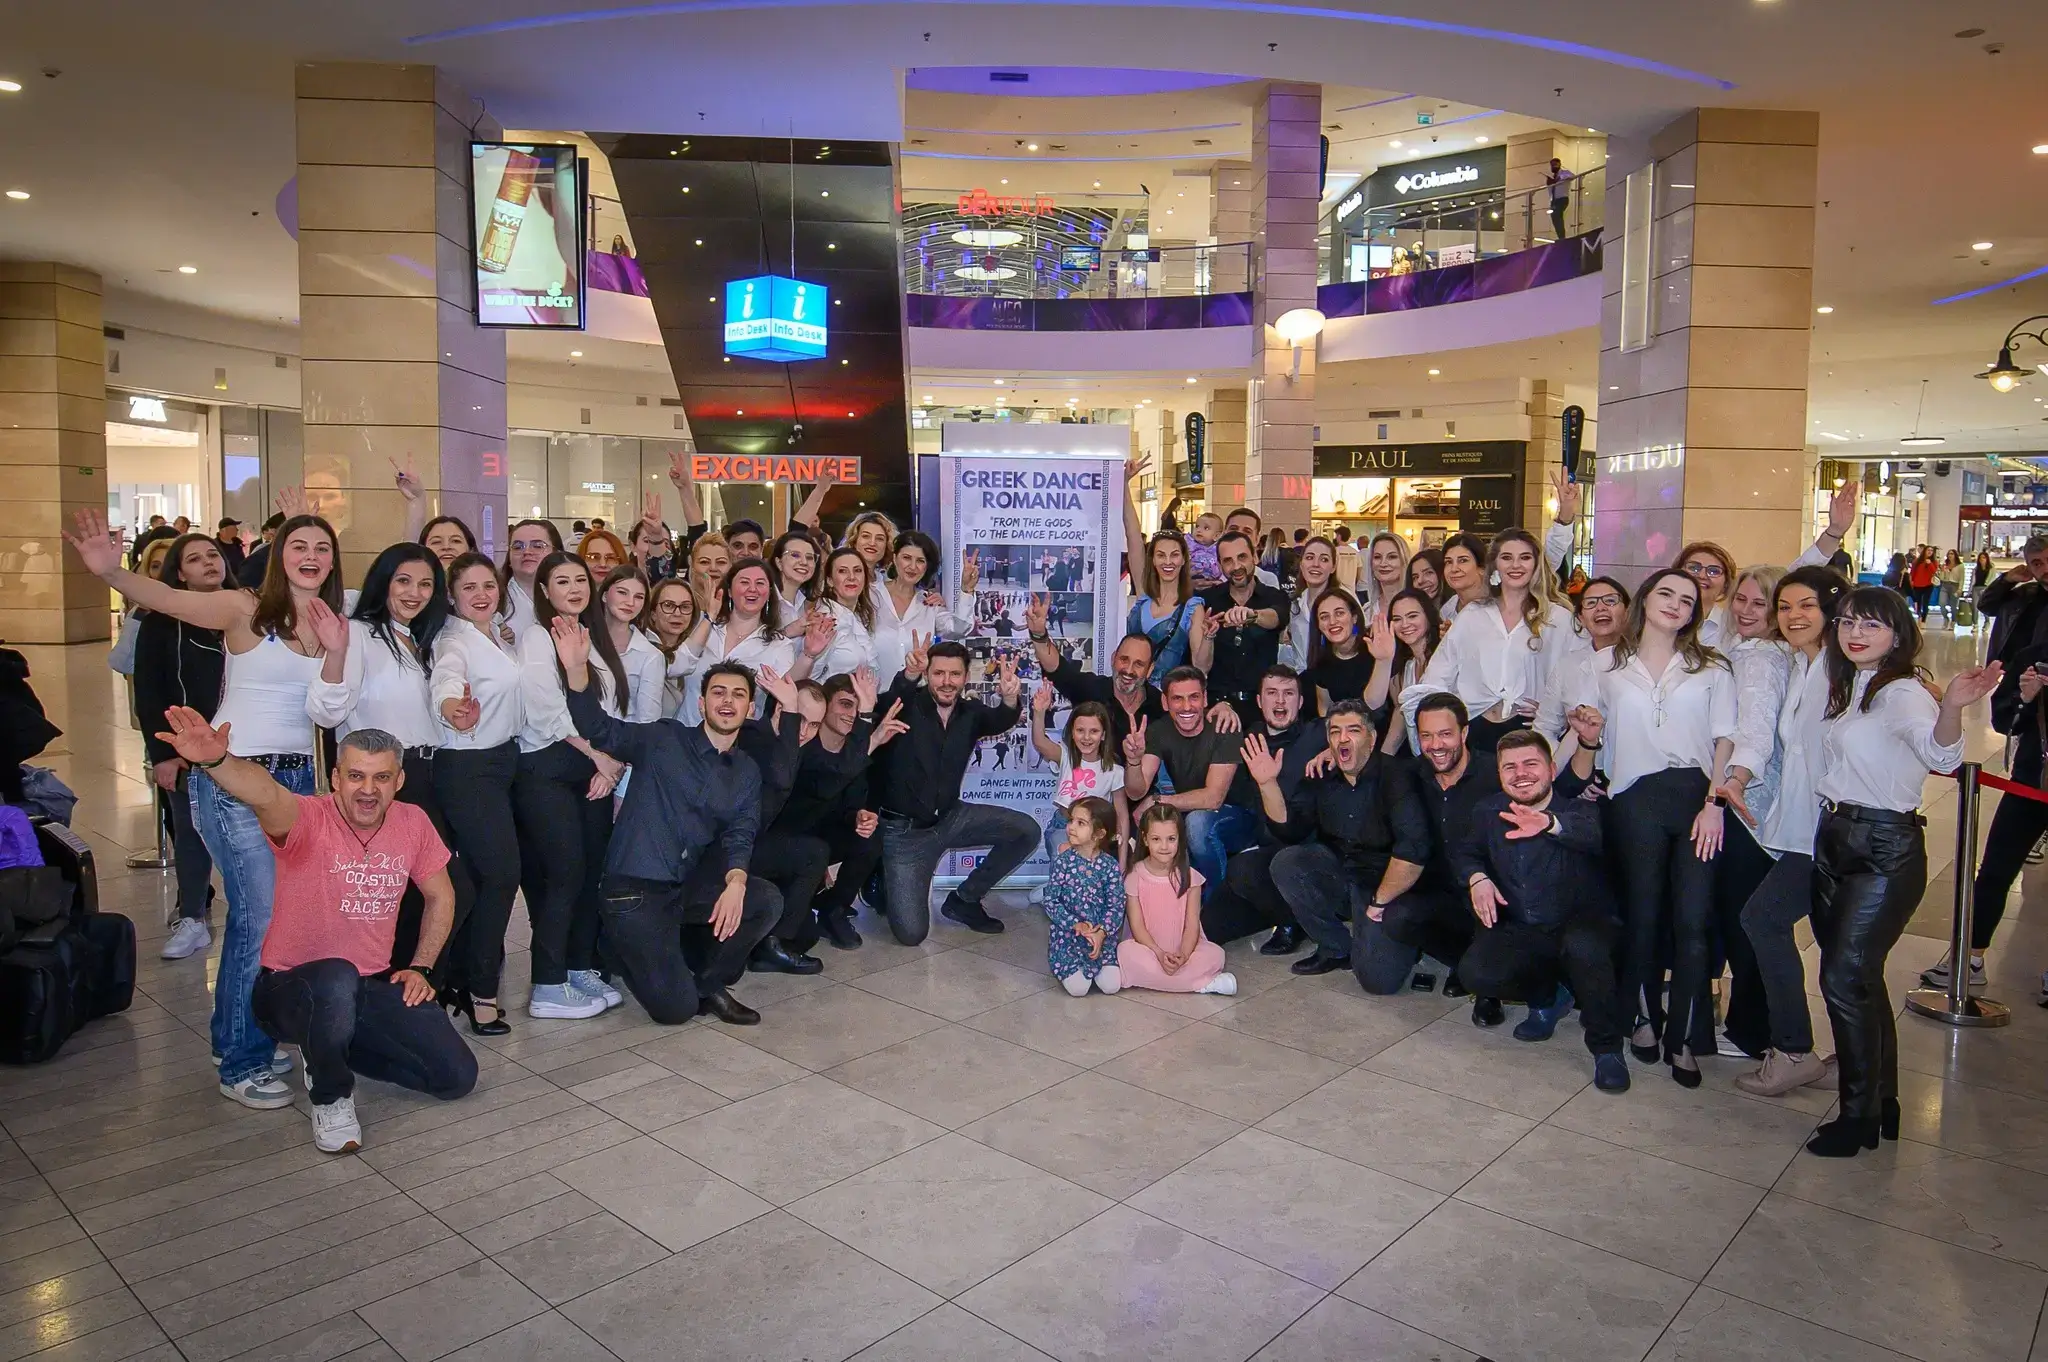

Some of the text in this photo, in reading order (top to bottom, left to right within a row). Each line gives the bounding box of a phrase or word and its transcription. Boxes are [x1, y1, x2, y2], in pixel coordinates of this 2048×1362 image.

[1411, 165, 1479, 190] Columbia
[958, 190, 1055, 216] DERTOUR
[483, 294, 515, 306] WHAT
[517, 295, 536, 307] THE
[728, 324, 768, 337] Info Desk
[774, 323, 822, 340] Info Desk
[1350, 450, 1414, 468] PAUL
[691, 455, 857, 482] EXCHANGE
[962, 470, 1102, 490] GREEK DANCE
[982, 491, 1083, 510] ROMANIA
[1469, 499, 1502, 510] PAUL
[1023, 517, 1042, 527] THE
[1044, 518, 1072, 528] GODS
[973, 529, 986, 539] TO
[990, 529, 1008, 539] THE
[1011, 530, 1045, 539] DANCE
[981, 779, 1056, 787] DANCE WITH PASS
[962, 791, 991, 799] DANCE
[994, 791, 1014, 799] WITH
[1016, 792, 1022, 800] A
[345, 870, 403, 887] COASTAL
[339, 899, 398, 914] RACE 75
